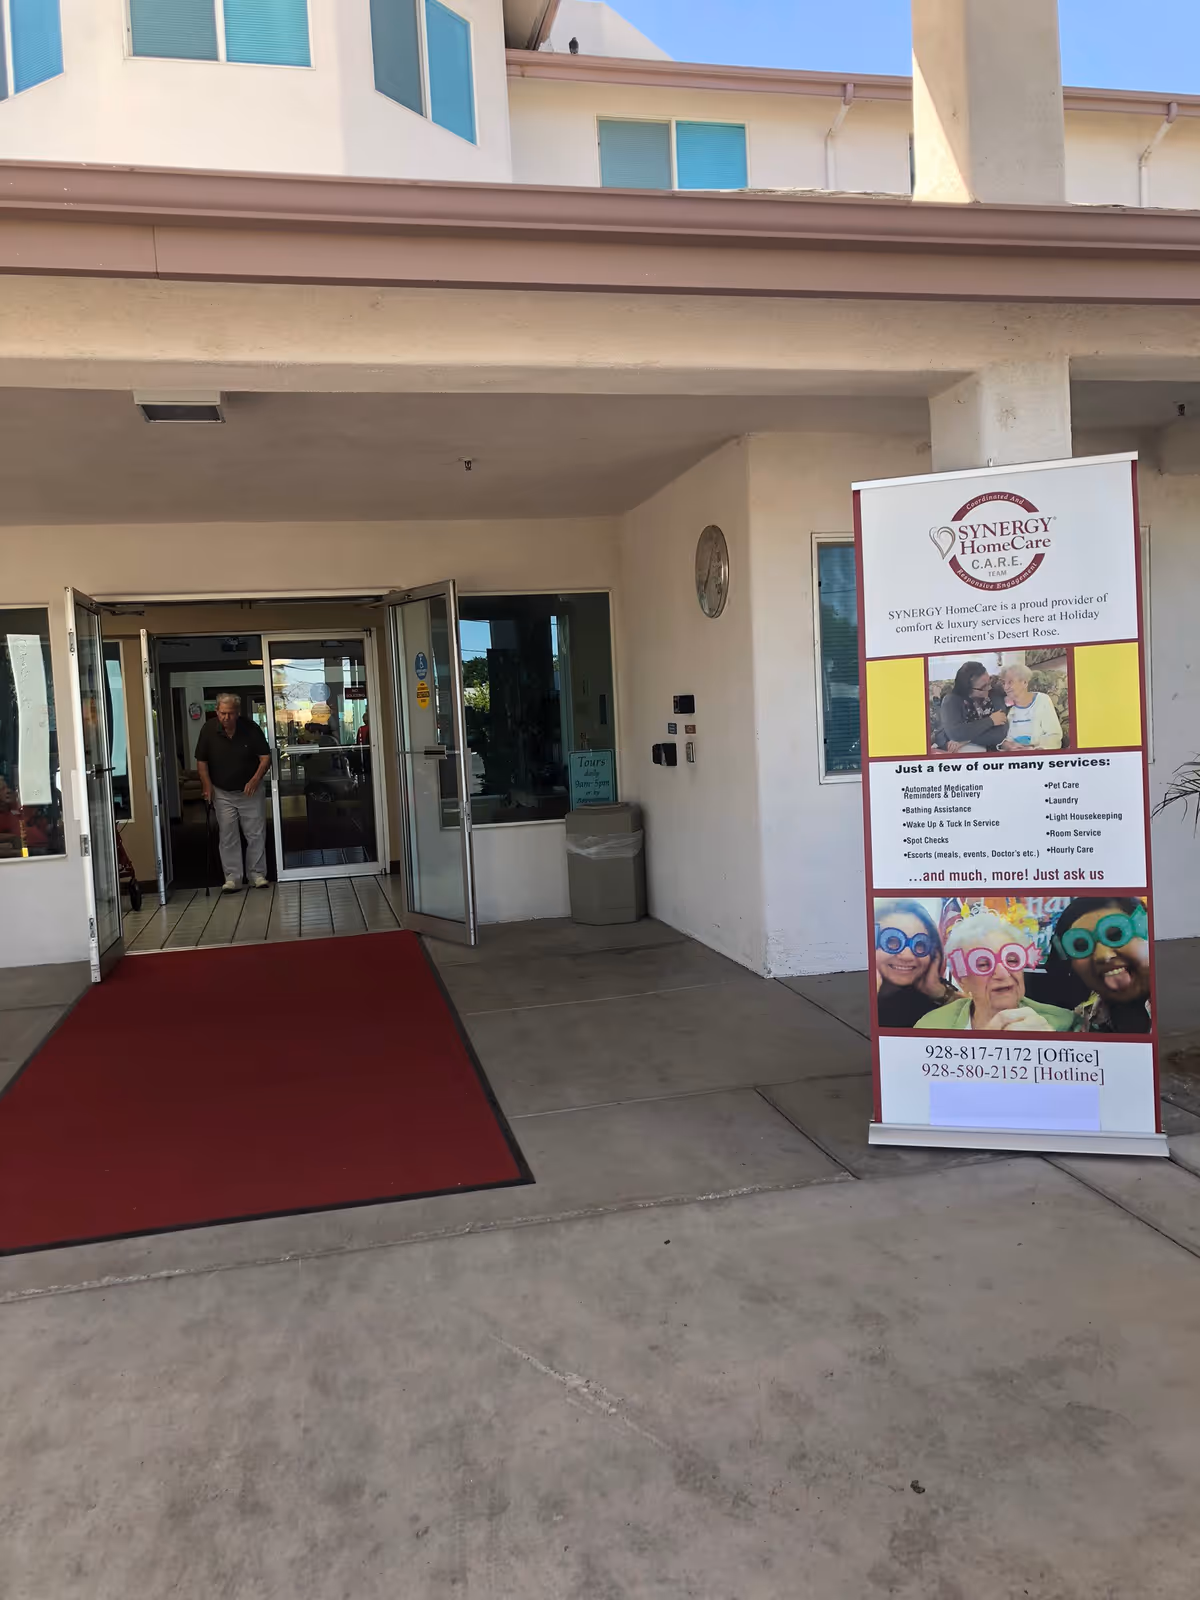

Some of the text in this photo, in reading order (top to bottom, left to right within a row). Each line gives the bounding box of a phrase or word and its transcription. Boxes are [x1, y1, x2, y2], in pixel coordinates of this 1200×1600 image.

[966, 494, 1024, 510] Coordinated And
[960, 536, 1051, 555] HomeCare
[971, 556, 1022, 570] C.A.R.E.
[957, 562, 1038, 589] Responsive Engagement
[888, 607, 942, 620] SYNERGY
[945, 603, 997, 615] HomeCare
[1000, 602, 1008, 610] is
[1020, 598, 1048, 611] proud
[1051, 595, 1093, 608] provider
[1097, 593, 1108, 603] of
[895, 610, 1099, 633] comfort & luxury services here at Holiday
[998, 630, 1029, 640] Desert
[1032, 627, 1060, 637] Rose.
[577, 756, 605, 767] Tours
[895, 758, 1111, 774] Just a few of our many services:
[905, 784, 984, 792] Automated Medication
[951, 791, 981, 799] Delivery
[1048, 796, 1079, 805] Laundry
[905, 805, 972, 814] Bathing Assistance
[1049, 812, 1123, 822] Light Housekeeping
[906, 821, 926, 829] Wake
[927, 821, 937, 829] Up
[973, 819, 1000, 827] Service
[907, 836, 949, 845] Spot Checks
[934, 850, 962, 860] (meals,
[963, 851, 989, 859] events,
[1022, 849, 1040, 858] etc.)
[1050, 846, 1074, 855] Hourly
[949, 870, 987, 882] much,
[992, 869, 1029, 881] more!
[1033, 868, 1060, 881] Just
[1063, 868, 1086, 880] ask
[1089, 868, 1105, 880] us
[925, 1045, 1100, 1066] 928-817-7172 [Office]
[922, 1063, 1105, 1085] 928-580-2152 [Hotline]
